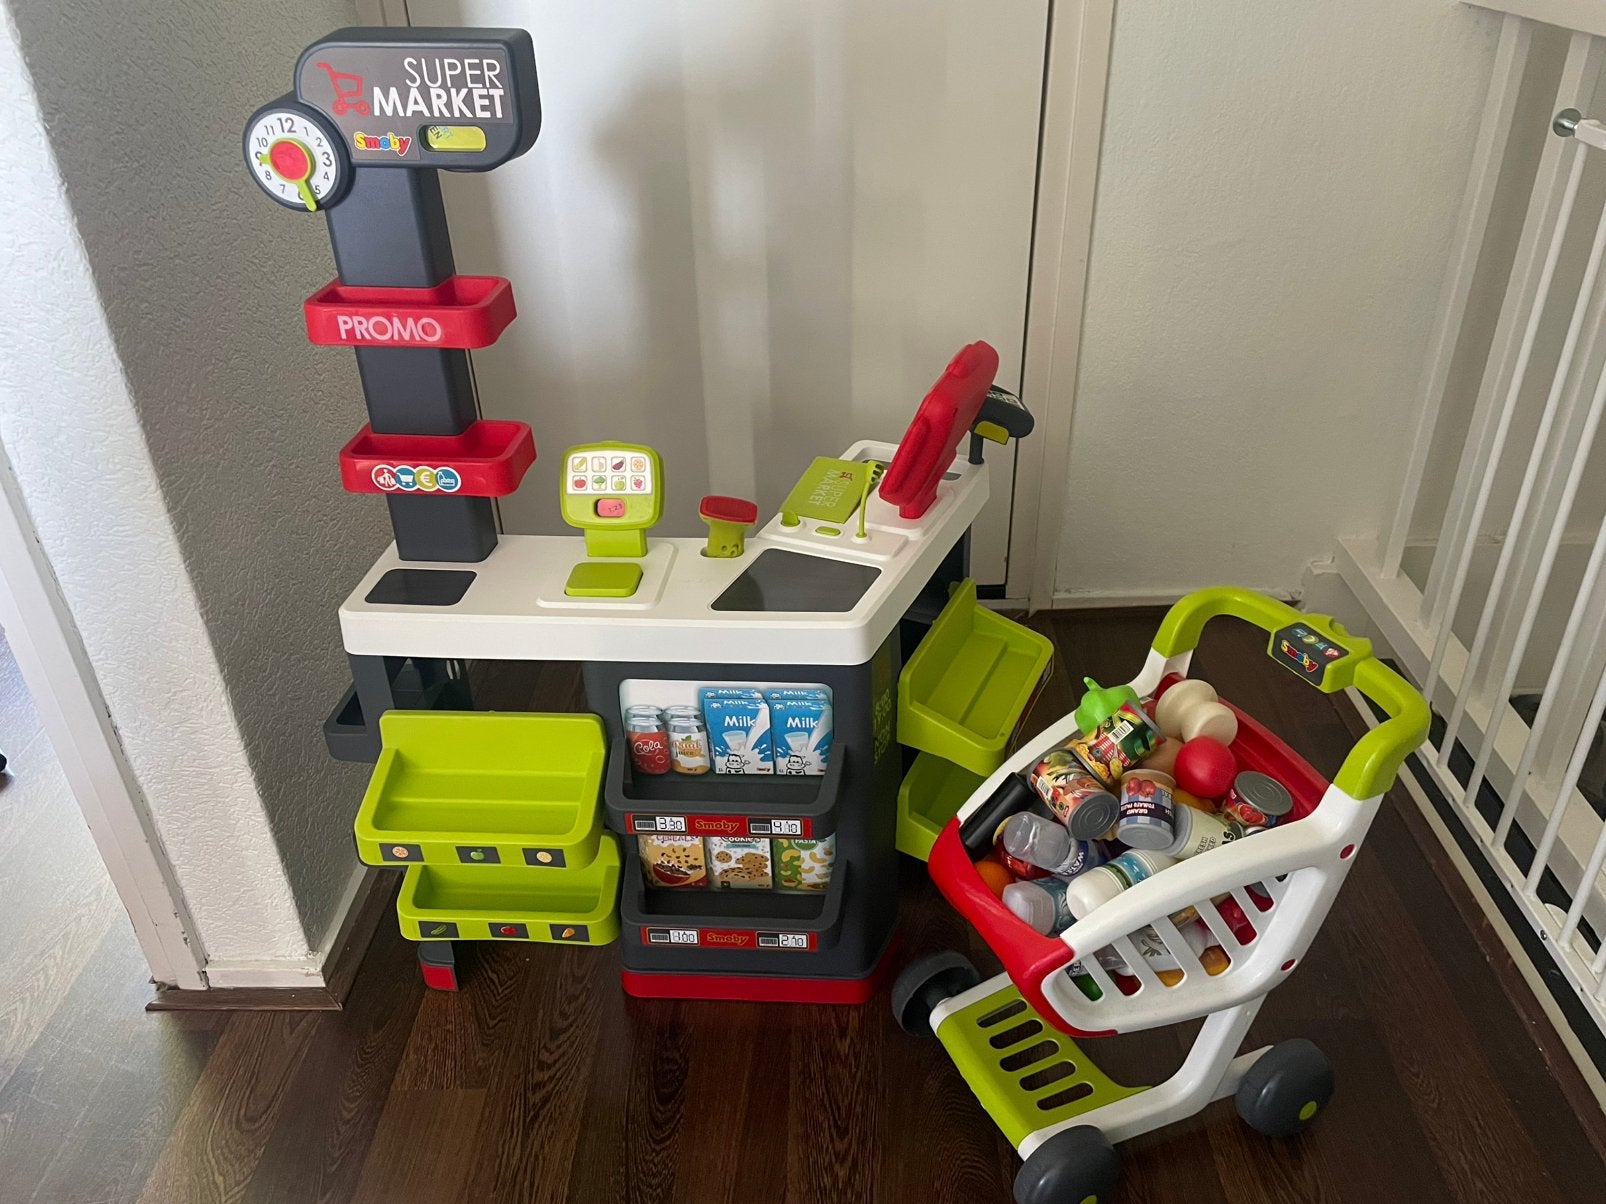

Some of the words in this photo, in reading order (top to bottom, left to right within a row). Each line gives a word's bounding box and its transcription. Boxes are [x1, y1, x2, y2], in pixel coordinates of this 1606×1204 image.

[403, 57, 501, 88] SUPER
[373, 86, 504, 119] MARKET
[264, 125, 275, 136] 11
[277, 117, 297, 133] 12
[304, 126, 309, 137] 1
[256, 137, 268, 148] 10
[316, 137, 323, 147] 2
[354, 132, 411, 156] Smoby
[322, 151, 333, 167] 3
[264, 171, 272, 181] 8
[323, 171, 330, 182] 4
[280, 184, 286, 194] 7
[315, 185, 321, 195] 5
[337, 315, 442, 342] PROMO
[1280, 639, 1319, 673] Smoby
[724, 715, 756, 727] Milk
[787, 717, 819, 728] Milk
[633, 740, 664, 756] Cola
[695, 819, 739, 833] Smoby
[706, 932, 749, 945] Smoby
